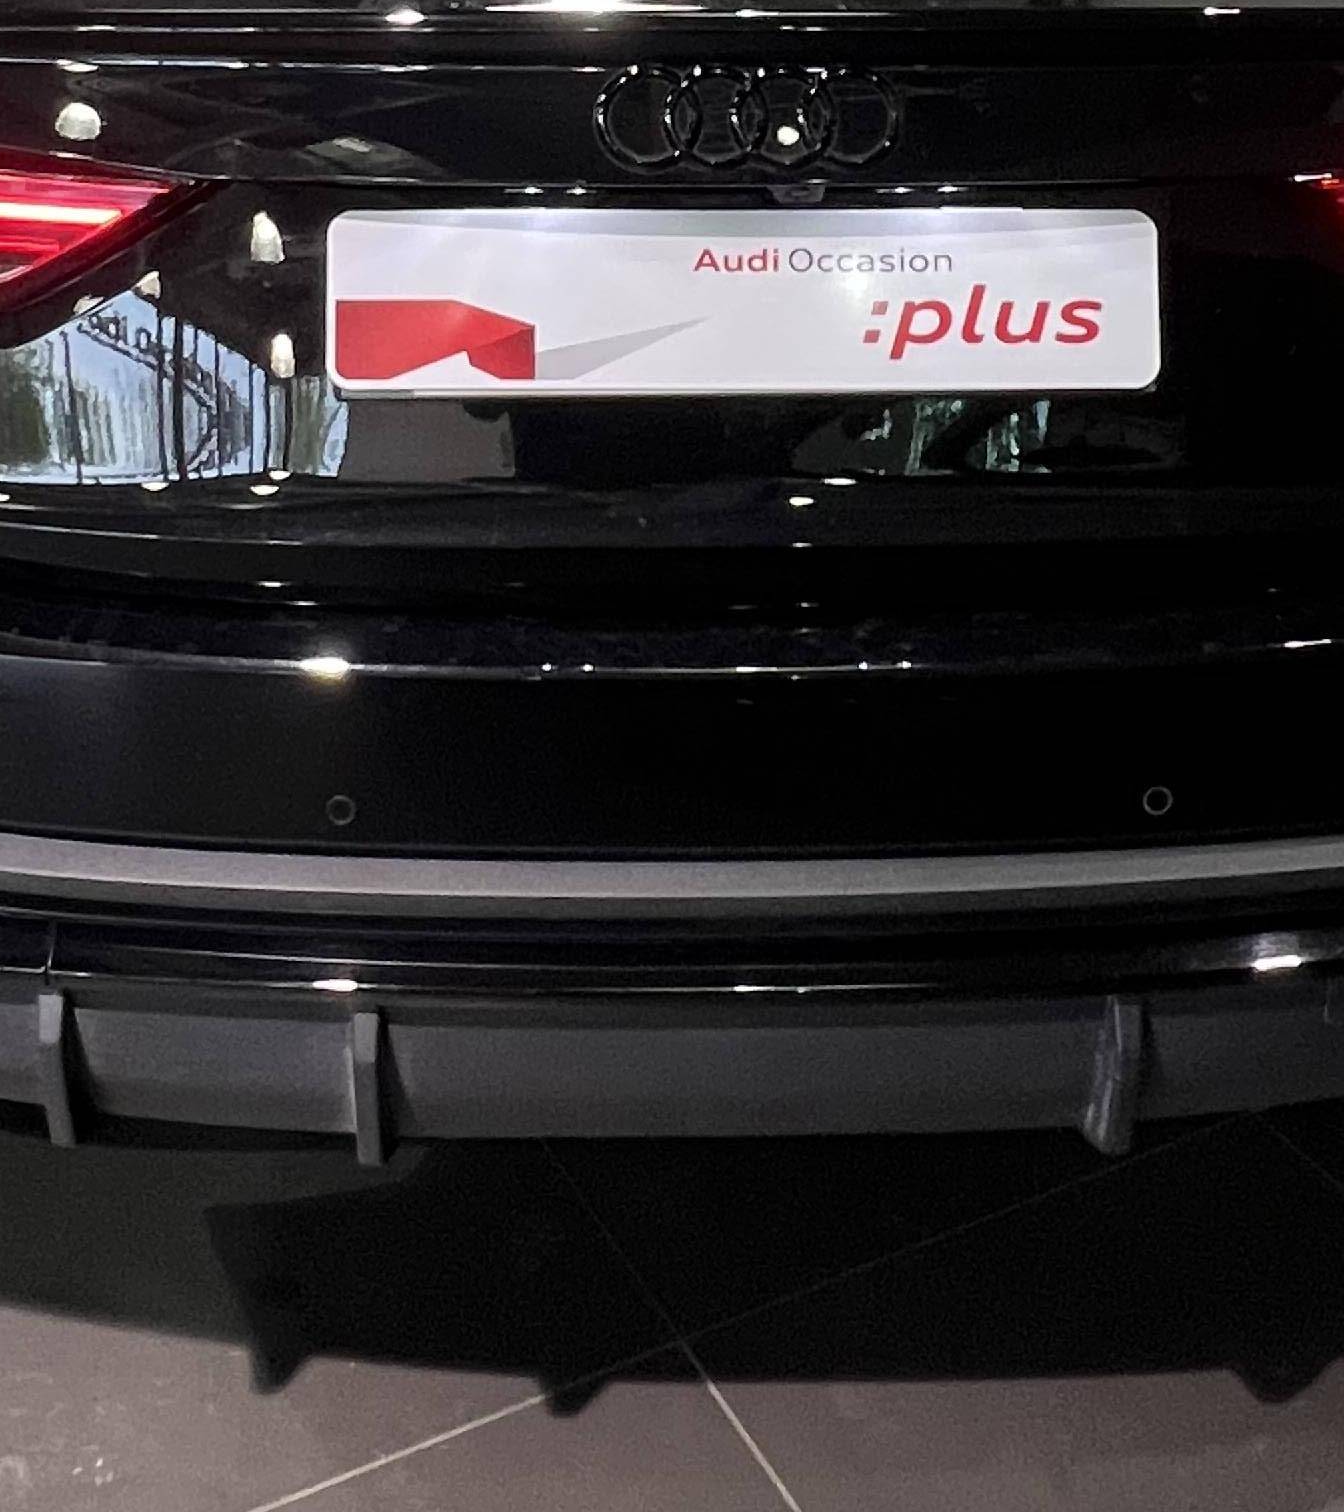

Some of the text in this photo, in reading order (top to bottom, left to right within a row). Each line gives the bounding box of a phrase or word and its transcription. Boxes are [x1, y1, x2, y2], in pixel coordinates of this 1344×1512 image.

[693, 247, 954, 274] Audi Occasion
[862, 283, 1104, 361] :plus
